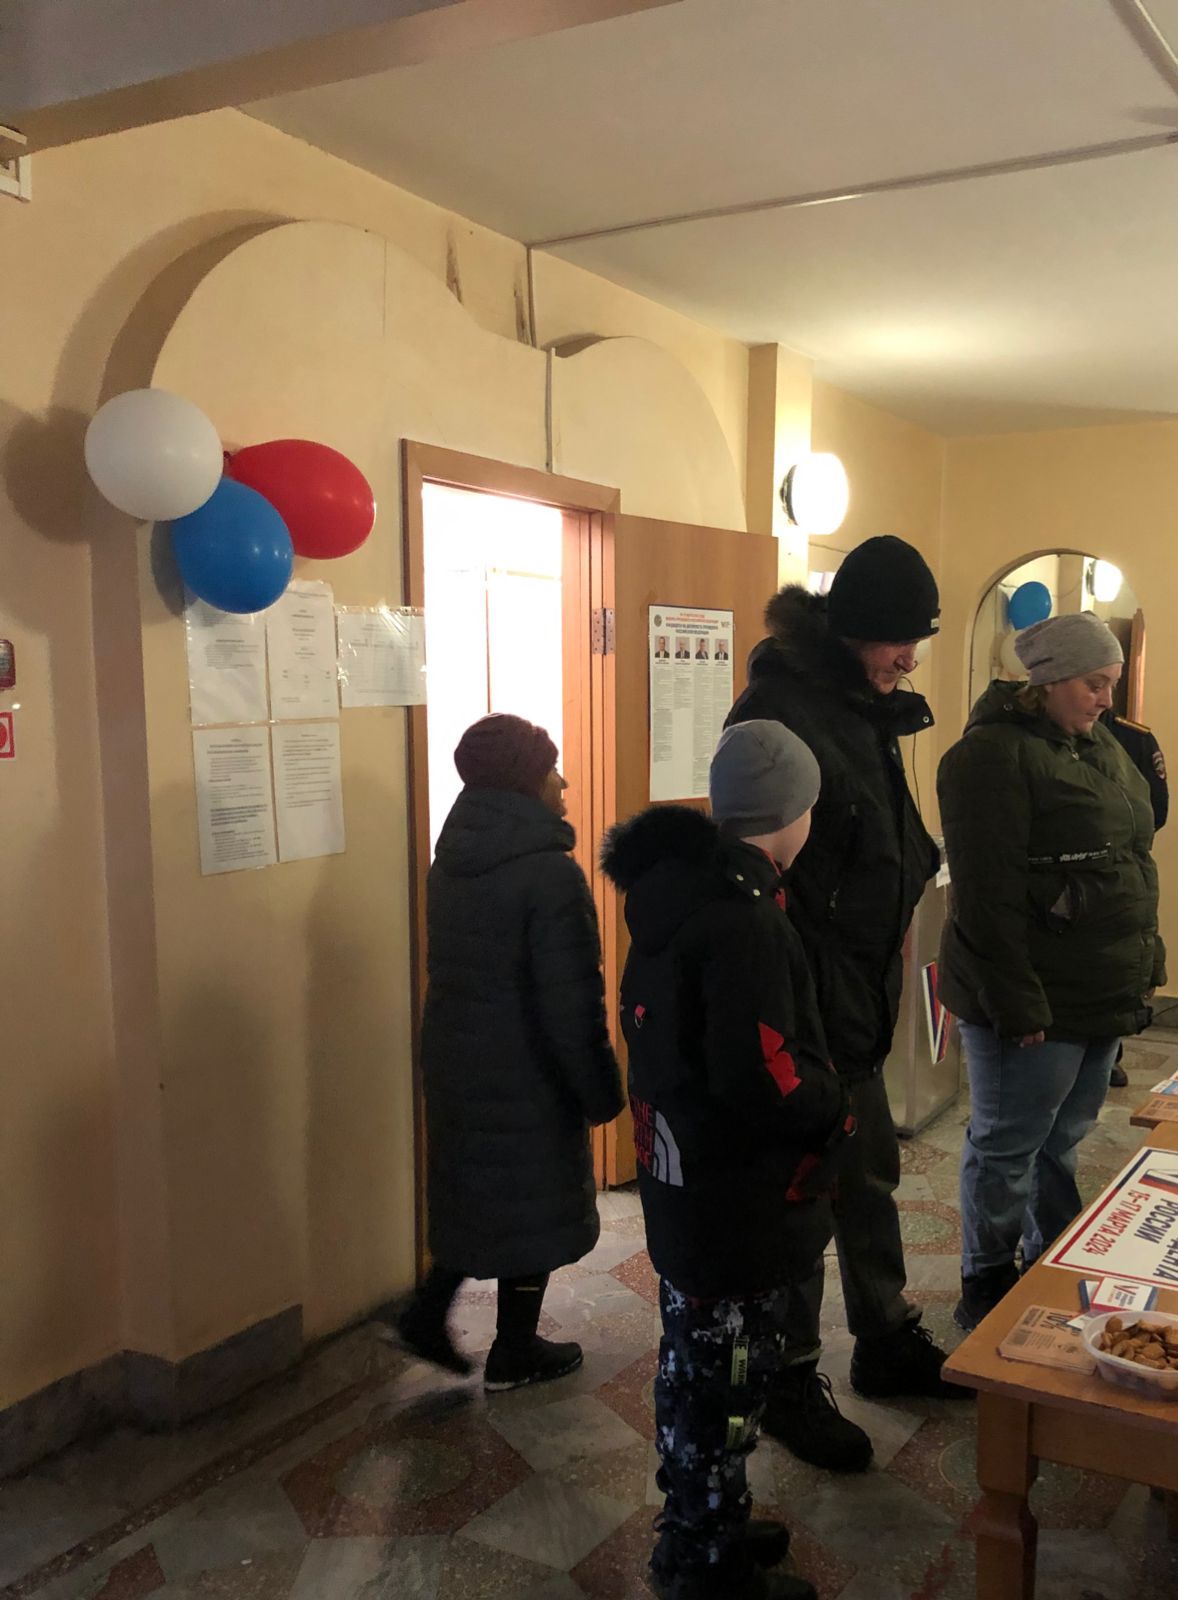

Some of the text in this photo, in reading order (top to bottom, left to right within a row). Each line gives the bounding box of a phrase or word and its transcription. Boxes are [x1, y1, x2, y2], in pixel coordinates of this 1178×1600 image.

[1098, 1208, 1133, 1236] МАРТА
[1134, 1198, 1178, 1244] РОССИИ
[1082, 1233, 1116, 1256] 2024
